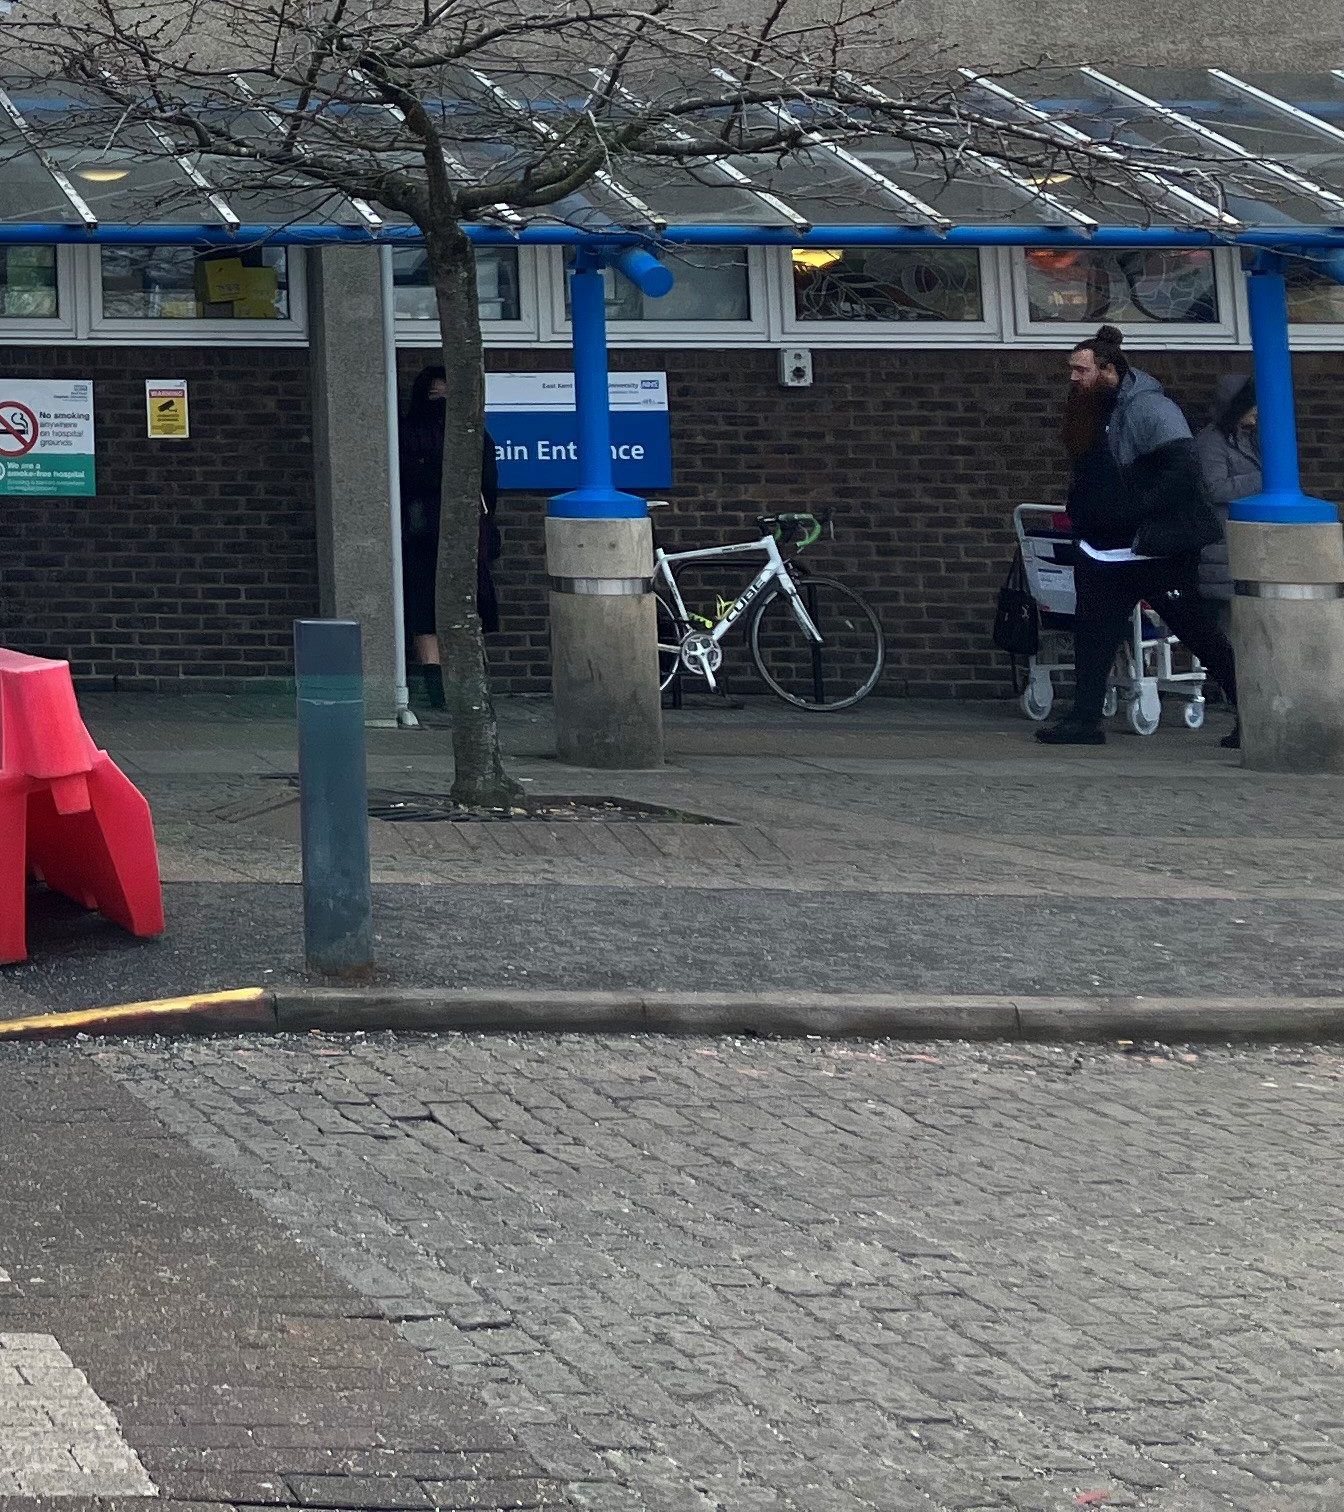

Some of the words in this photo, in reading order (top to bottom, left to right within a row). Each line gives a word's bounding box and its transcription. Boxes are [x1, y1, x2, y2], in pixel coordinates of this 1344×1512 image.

[641, 380, 659, 388] NHS
[39, 411, 51, 419] No
[54, 412, 90, 420] smoking
[52, 429, 84, 438] hospital
[39, 439, 73, 447] grounds
[495, 440, 528, 460] ain
[7, 470, 52, 478] smoke-free
[53, 470, 85, 479] hospital
[726, 579, 767, 623] CUBE
